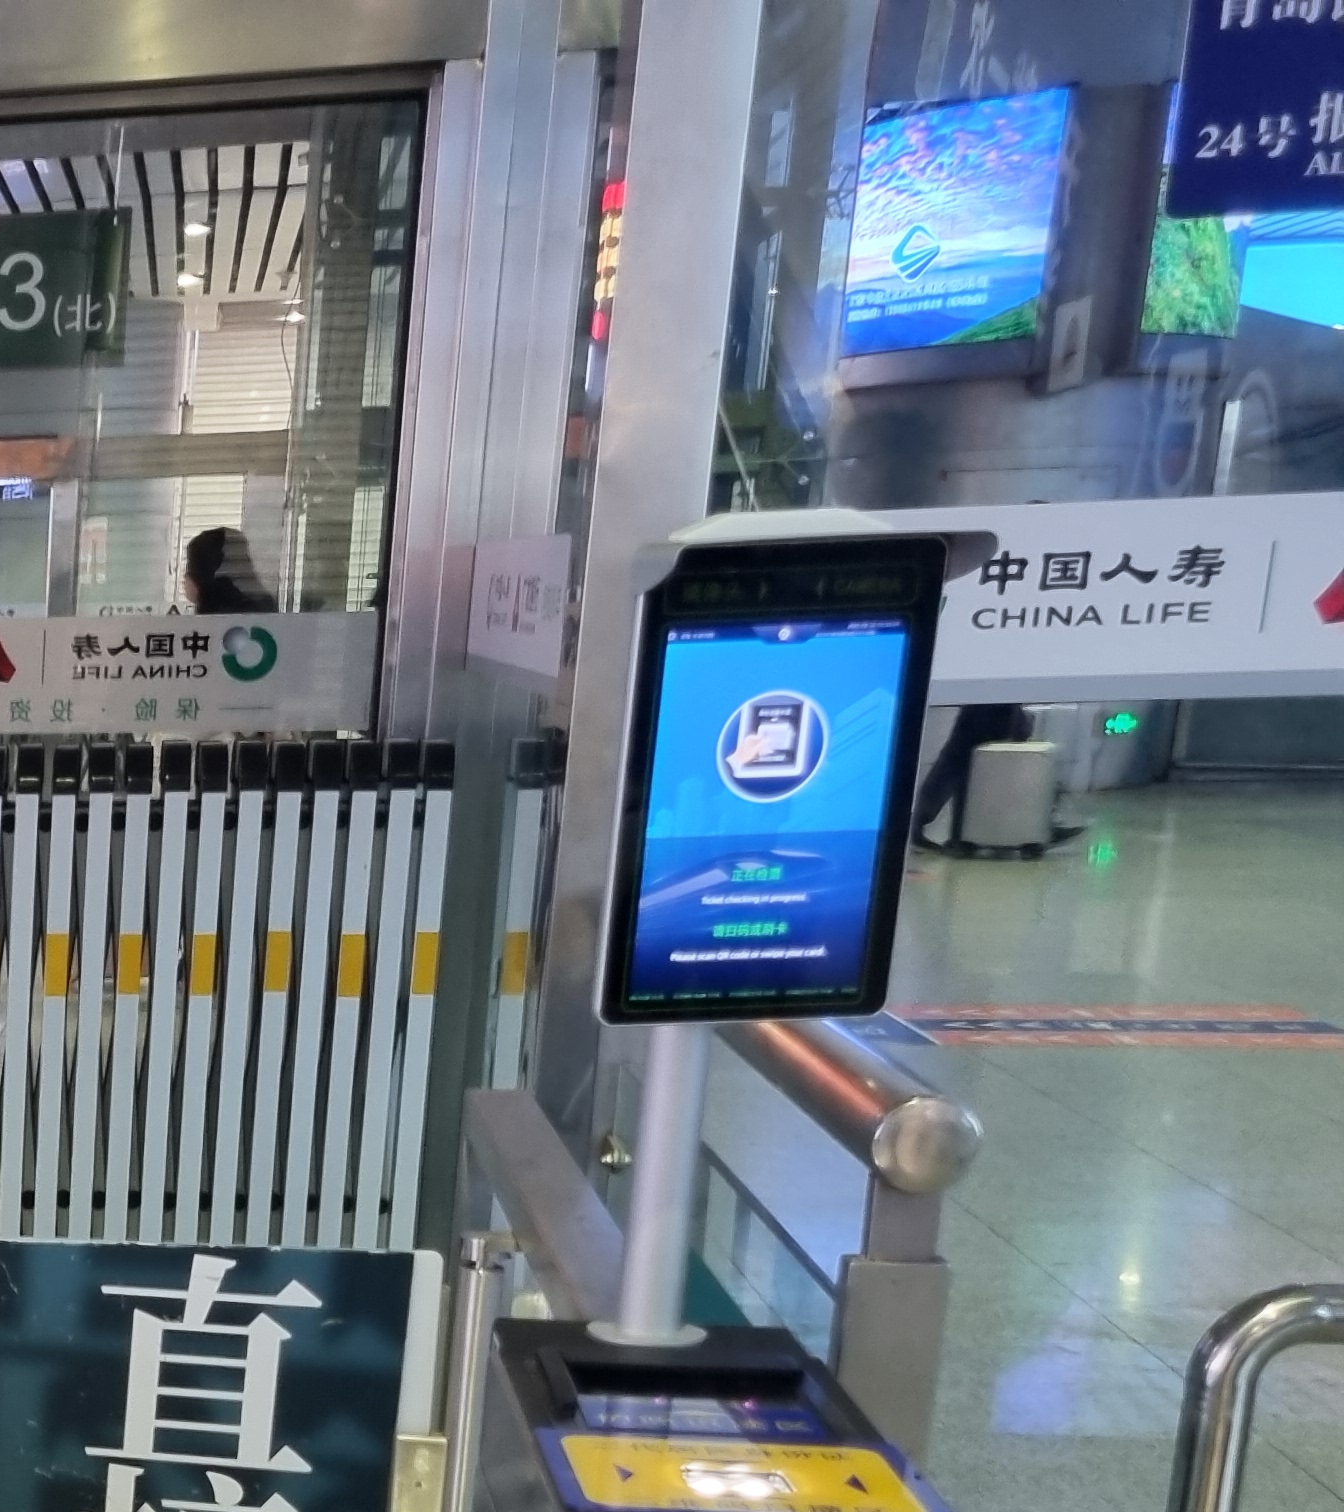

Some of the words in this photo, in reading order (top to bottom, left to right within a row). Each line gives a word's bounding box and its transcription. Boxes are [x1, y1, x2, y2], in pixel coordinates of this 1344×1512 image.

[979, 545, 1225, 595] 中国人寿
[971, 604, 1104, 630] CHINA
[1120, 601, 1212, 625] LIFE
[697, 951, 716, 961] scan
[730, 948, 750, 960] code
